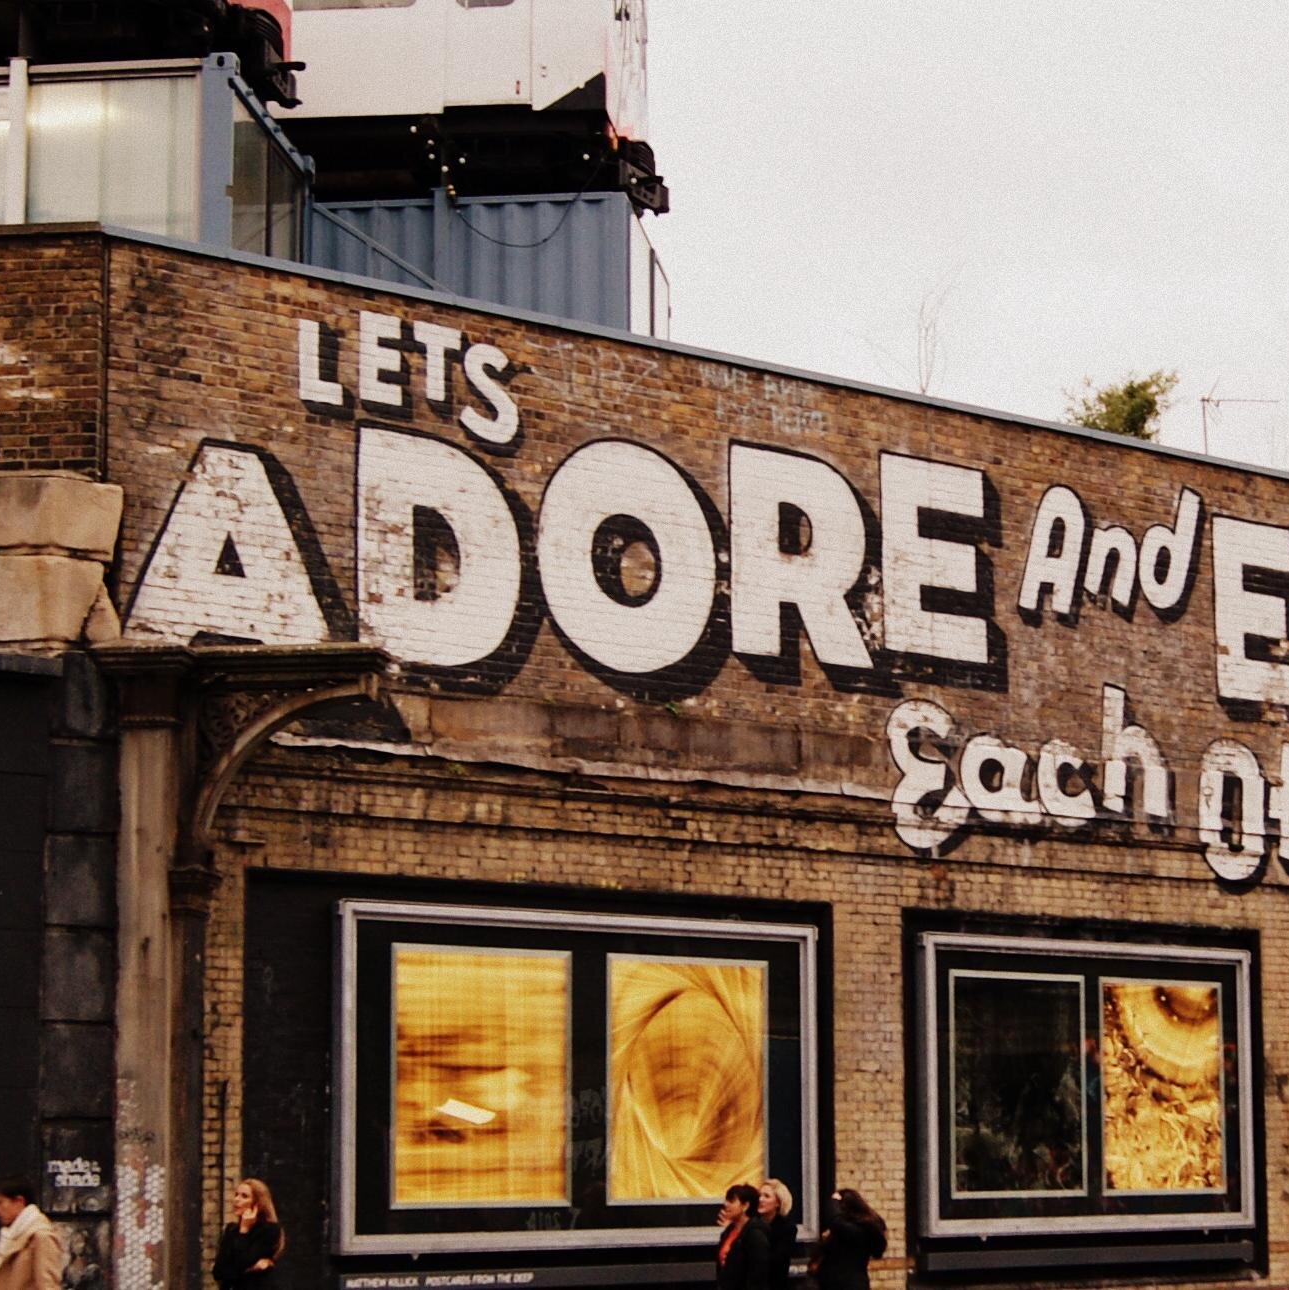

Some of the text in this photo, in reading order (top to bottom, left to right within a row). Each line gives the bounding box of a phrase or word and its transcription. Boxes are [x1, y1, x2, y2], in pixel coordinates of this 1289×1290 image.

[298, 310, 523, 450] LETS
[122, 424, 998, 682] ADORE
[1019, 485, 1202, 618] And
[886, 683, 1171, 854] Each
[496, 1273, 512, 1284] THE
